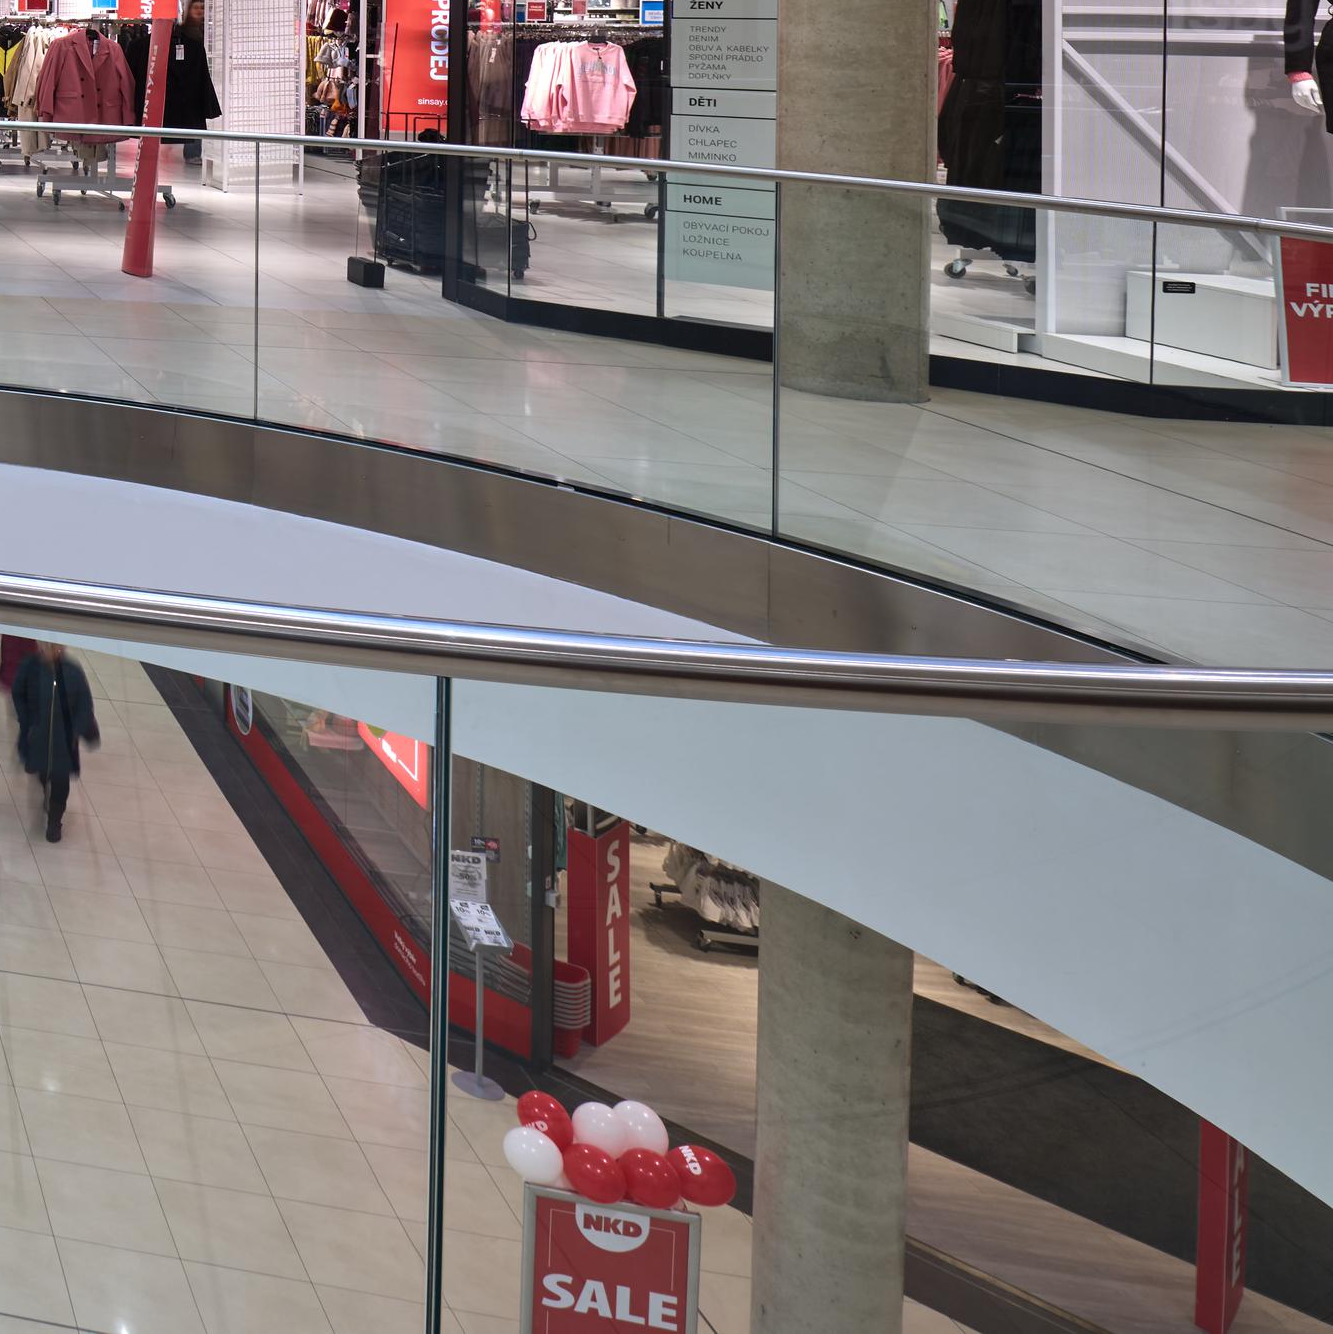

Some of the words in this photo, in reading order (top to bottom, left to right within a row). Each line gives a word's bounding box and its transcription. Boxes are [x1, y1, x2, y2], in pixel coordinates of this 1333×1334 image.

[689, 0, 724, 10] ŽENY
[688, 44, 713, 52] OBUV
[716, 44, 723, 52] A
[726, 45, 769, 53] KABELKY
[688, 53, 724, 61] SPODNÍ
[726, 53, 764, 62] PRÁDLO
[688, 62, 727, 71] PYŽAMA
[688, 71, 732, 80] DOPLŇKY
[689, 96, 717, 107] DĚTI
[688, 124, 720, 133] DÍVKA
[688, 137, 738, 148] CHLAPEC
[688, 151, 737, 162] MIMINKO
[683, 194, 722, 206] HOME
[731, 225, 770, 237] POKOJ
[683, 234, 730, 246] LOŽNICE
[683, 248, 742, 261] KOUPELNA
[451, 854, 481, 864] NKD
[606, 839, 622, 1010] SALE
[678, 1145, 702, 1176] NKD
[583, 1213, 642, 1238] NKD
[541, 1272, 678, 1332] SALE
